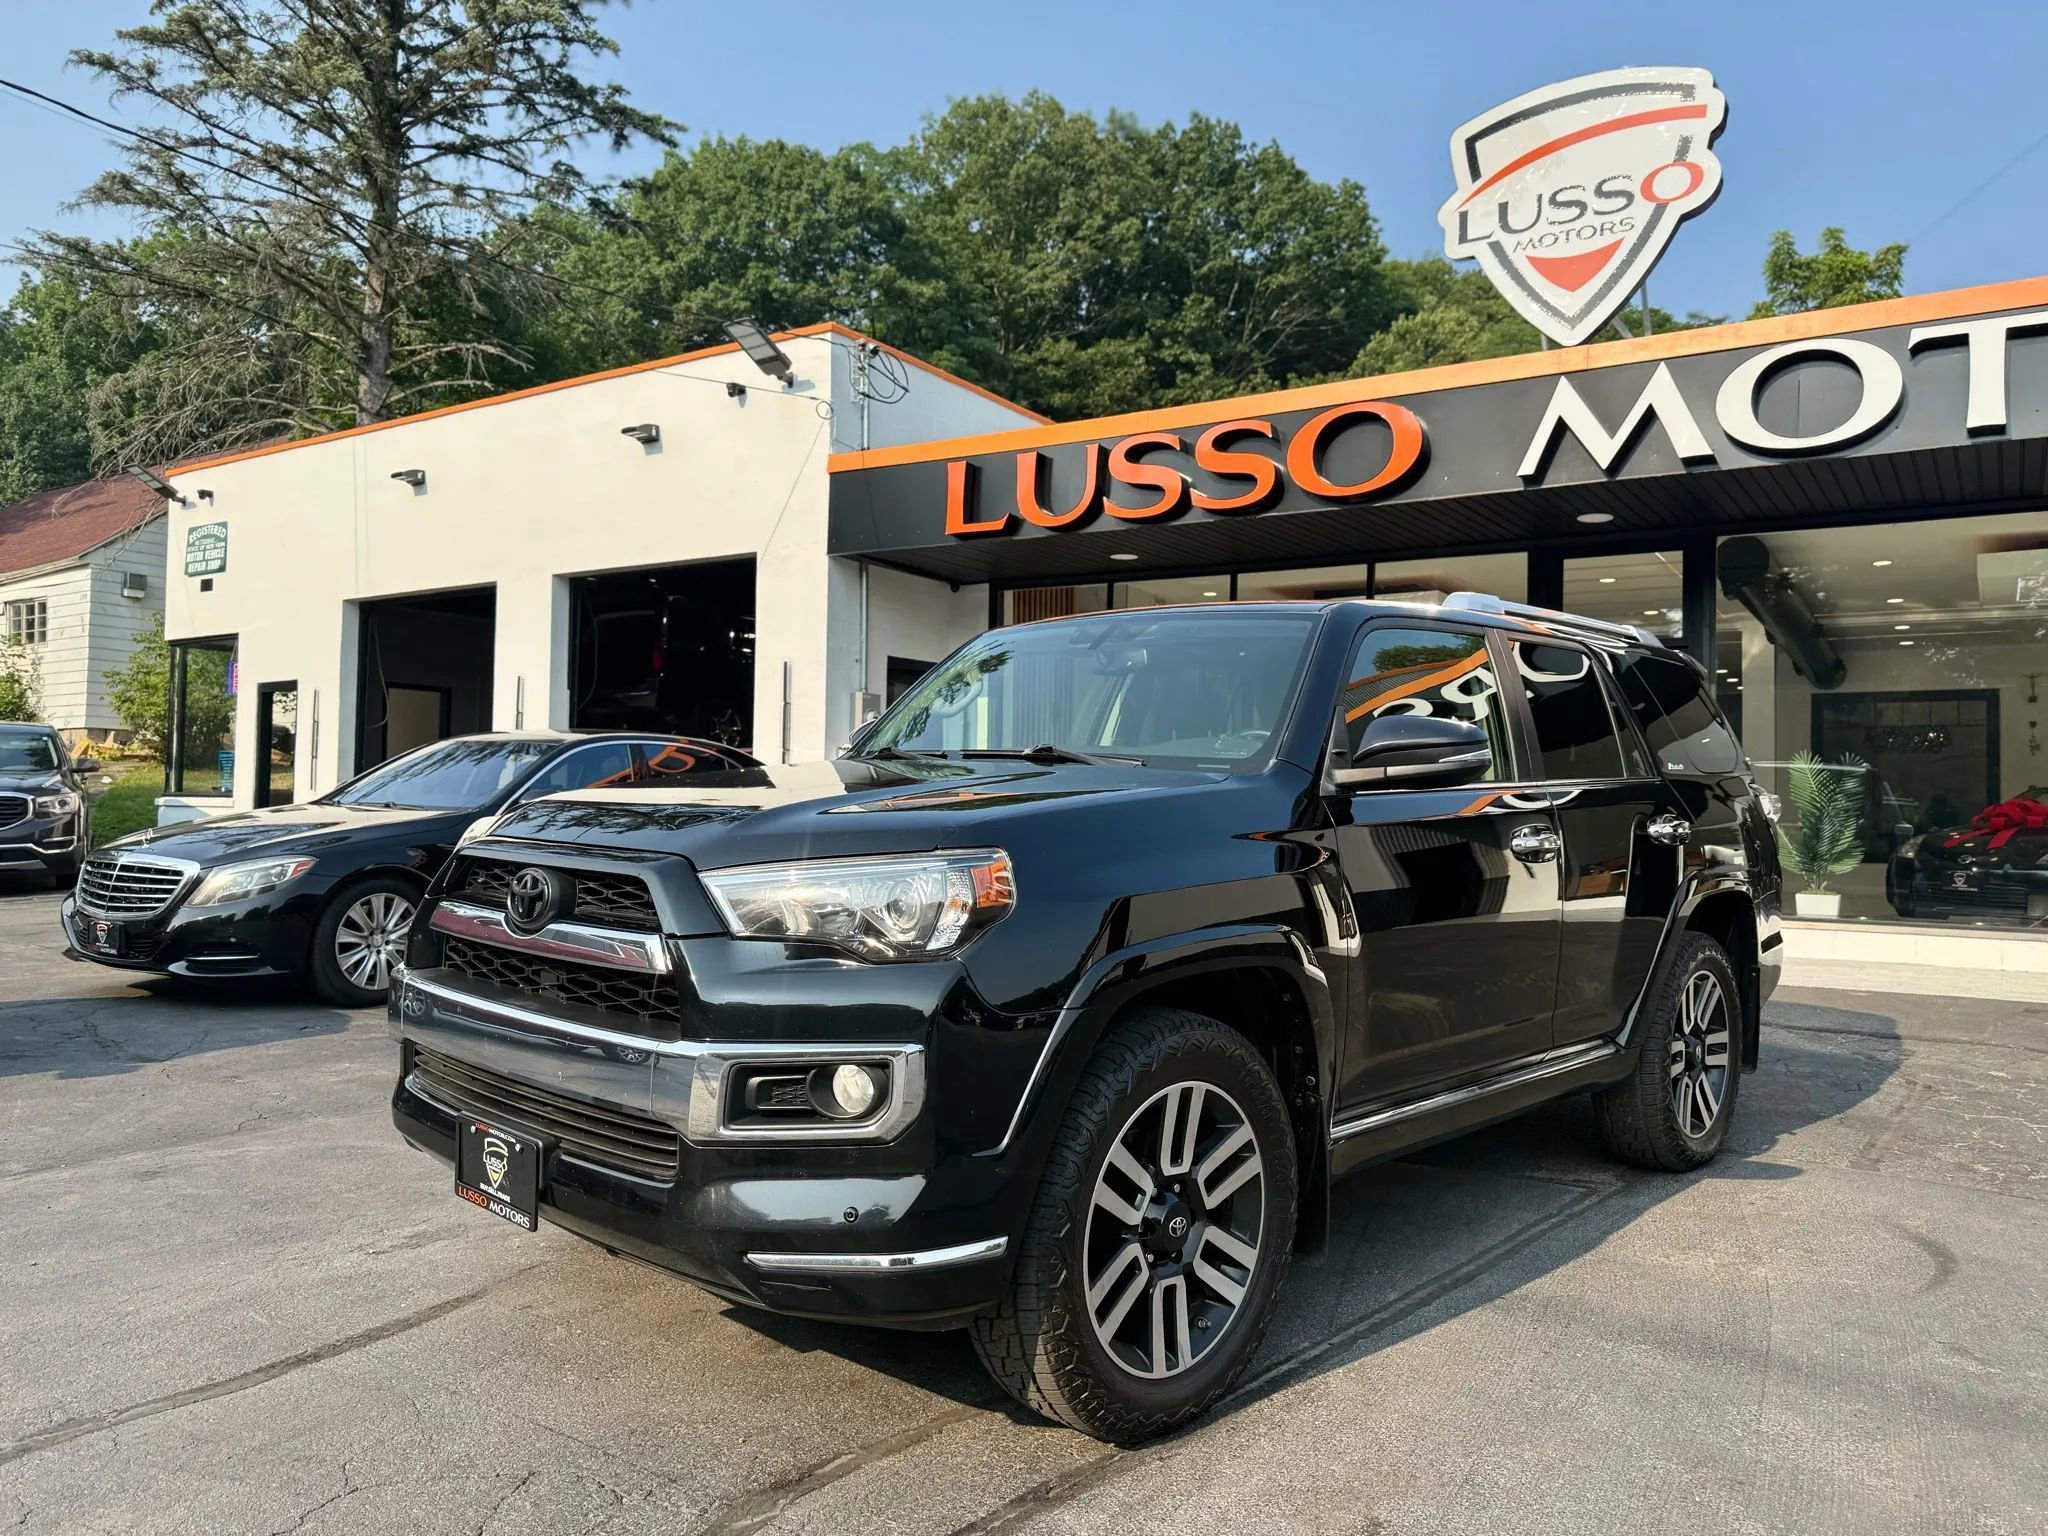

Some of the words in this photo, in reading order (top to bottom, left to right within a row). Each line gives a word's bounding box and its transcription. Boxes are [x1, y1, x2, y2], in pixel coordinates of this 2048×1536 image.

[1458, 161, 1704, 245] LUSSO
[1512, 216, 1635, 253] MOTORS
[945, 401, 1424, 535] LUSSO
[1516, 311, 2048, 477] MOT
[189, 525, 226, 544] REGISTERED
[186, 551, 203, 562] MOTOR
[205, 547, 225, 560] VEHICLE
[187, 561, 206, 573] REPAIR
[207, 559, 221, 570] SHOP
[458, 1185, 488, 1208] LUSSO
[489, 1200, 530, 1229] MOTORS
